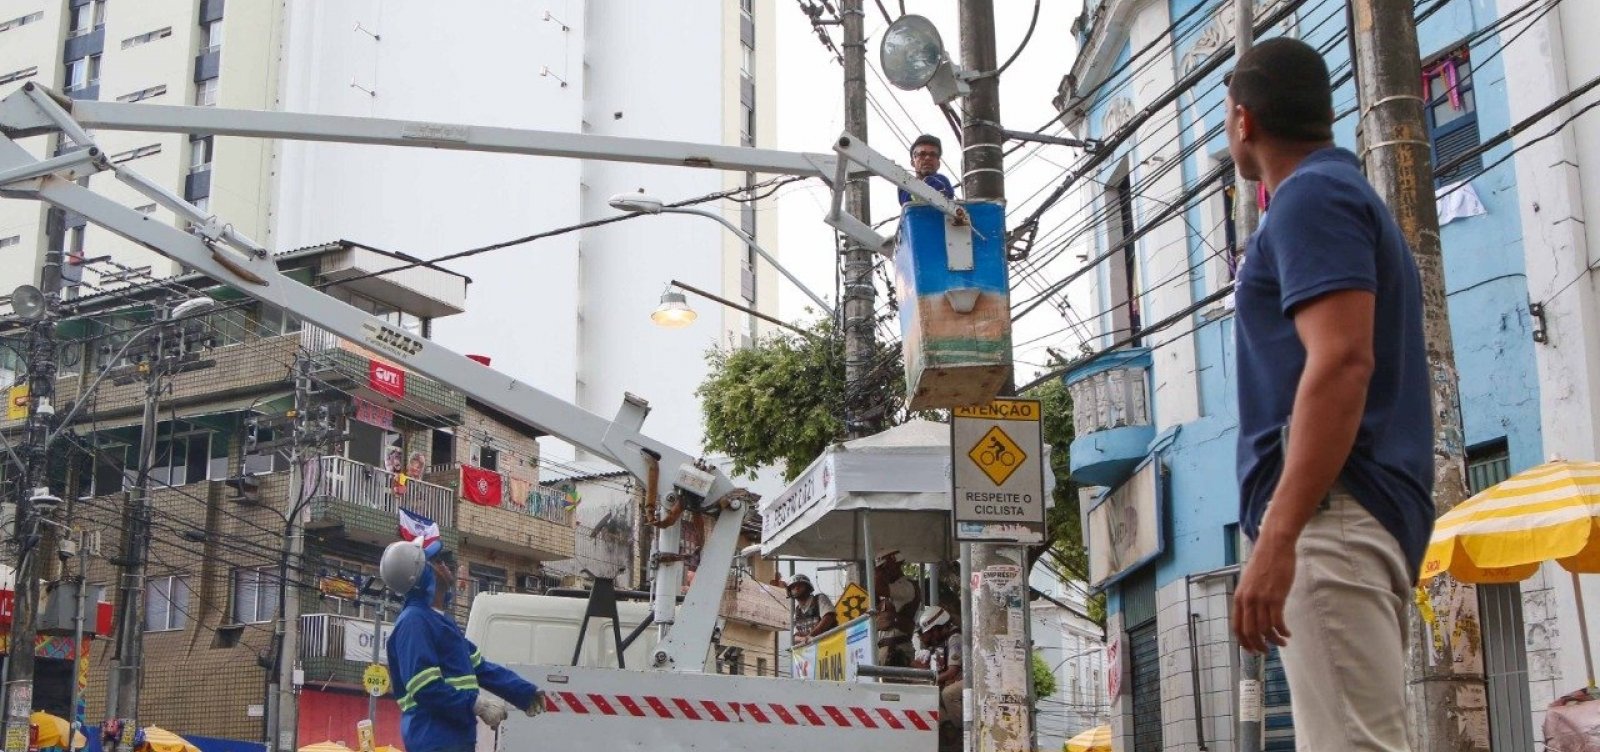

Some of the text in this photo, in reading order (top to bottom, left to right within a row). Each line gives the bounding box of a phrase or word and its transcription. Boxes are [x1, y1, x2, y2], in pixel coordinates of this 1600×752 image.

[966, 491, 1032, 504] RESPEITE O
[974, 505, 1025, 516] CICLISTA
